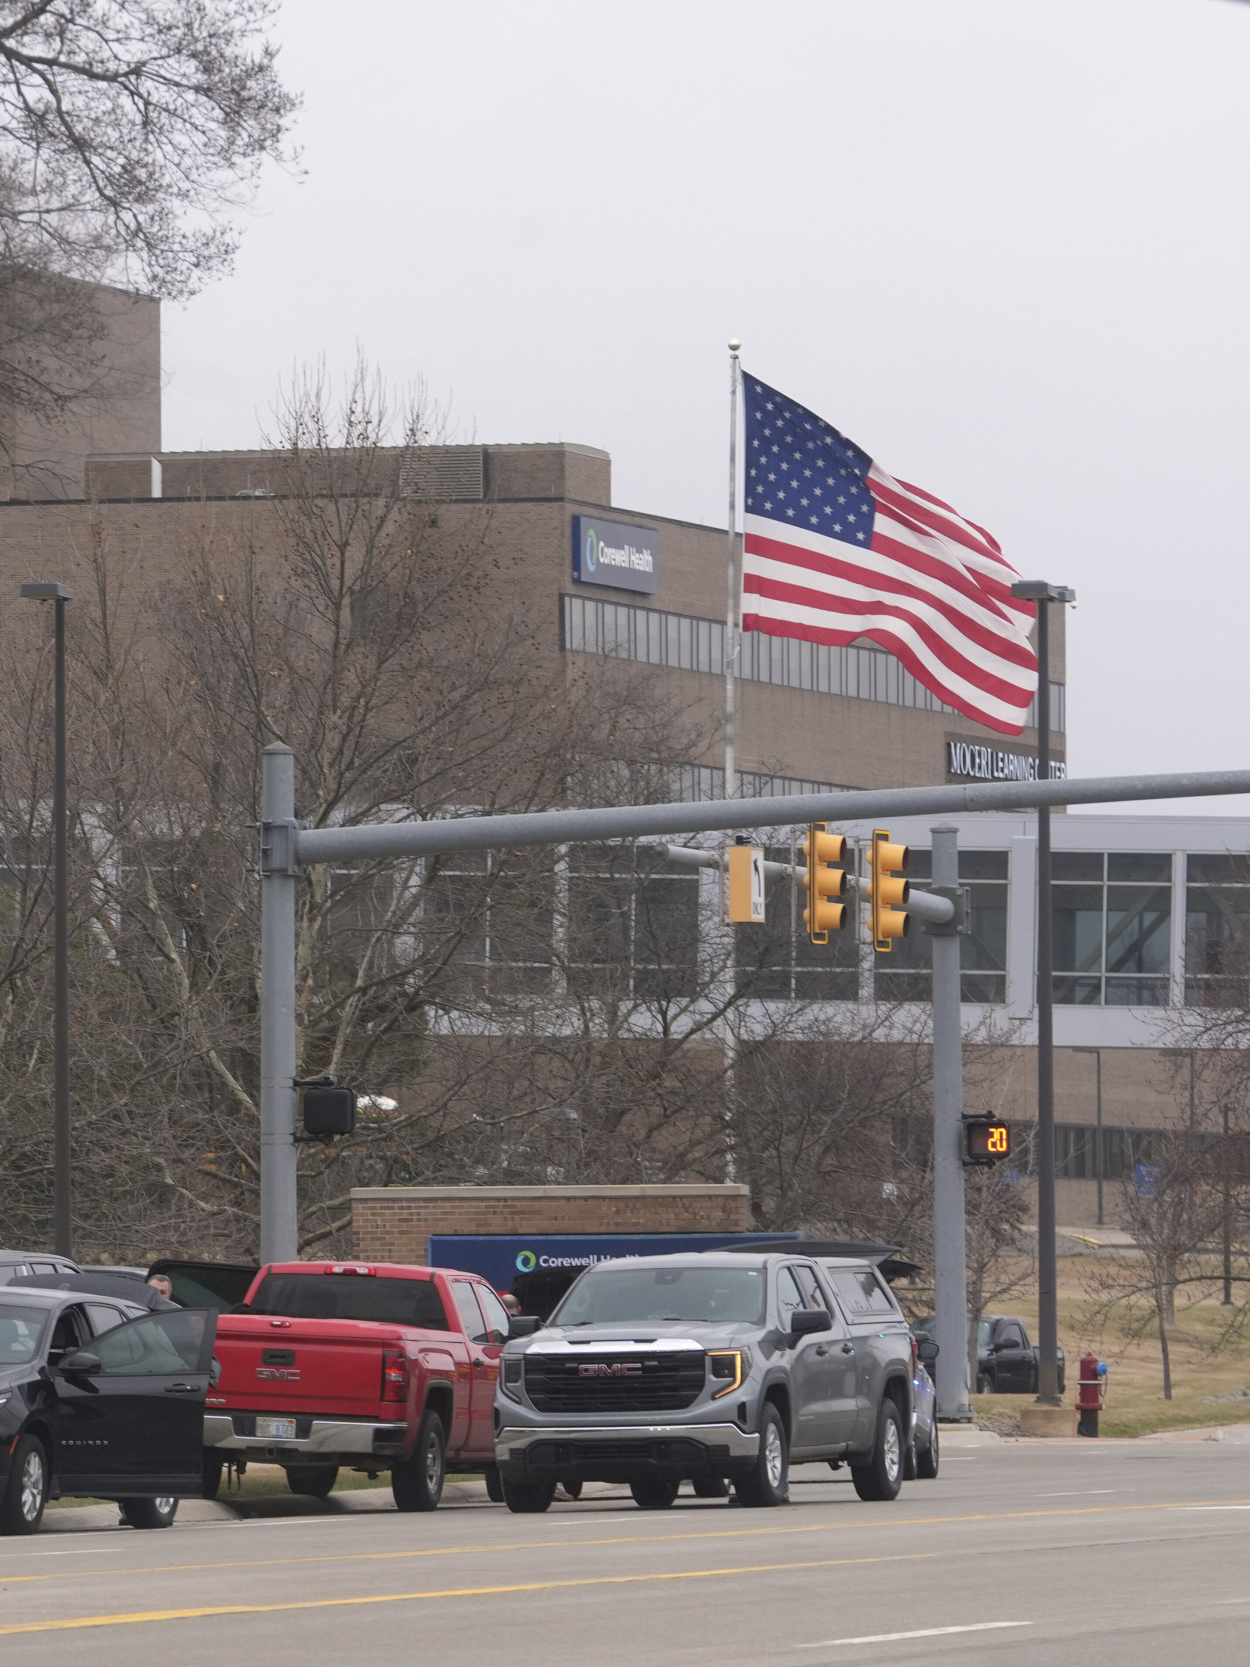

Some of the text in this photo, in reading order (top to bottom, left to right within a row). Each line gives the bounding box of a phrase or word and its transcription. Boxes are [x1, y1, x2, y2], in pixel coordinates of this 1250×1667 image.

[598, 540, 654, 573] Corewell Health
[950, 741, 1067, 781] MOCERI LEARNING CTER
[988, 1128, 1007, 1152] 20
[539, 1254, 597, 1268] Corewell
[255, 1368, 301, 1381] GMC
[579, 1363, 642, 1377] GMC
